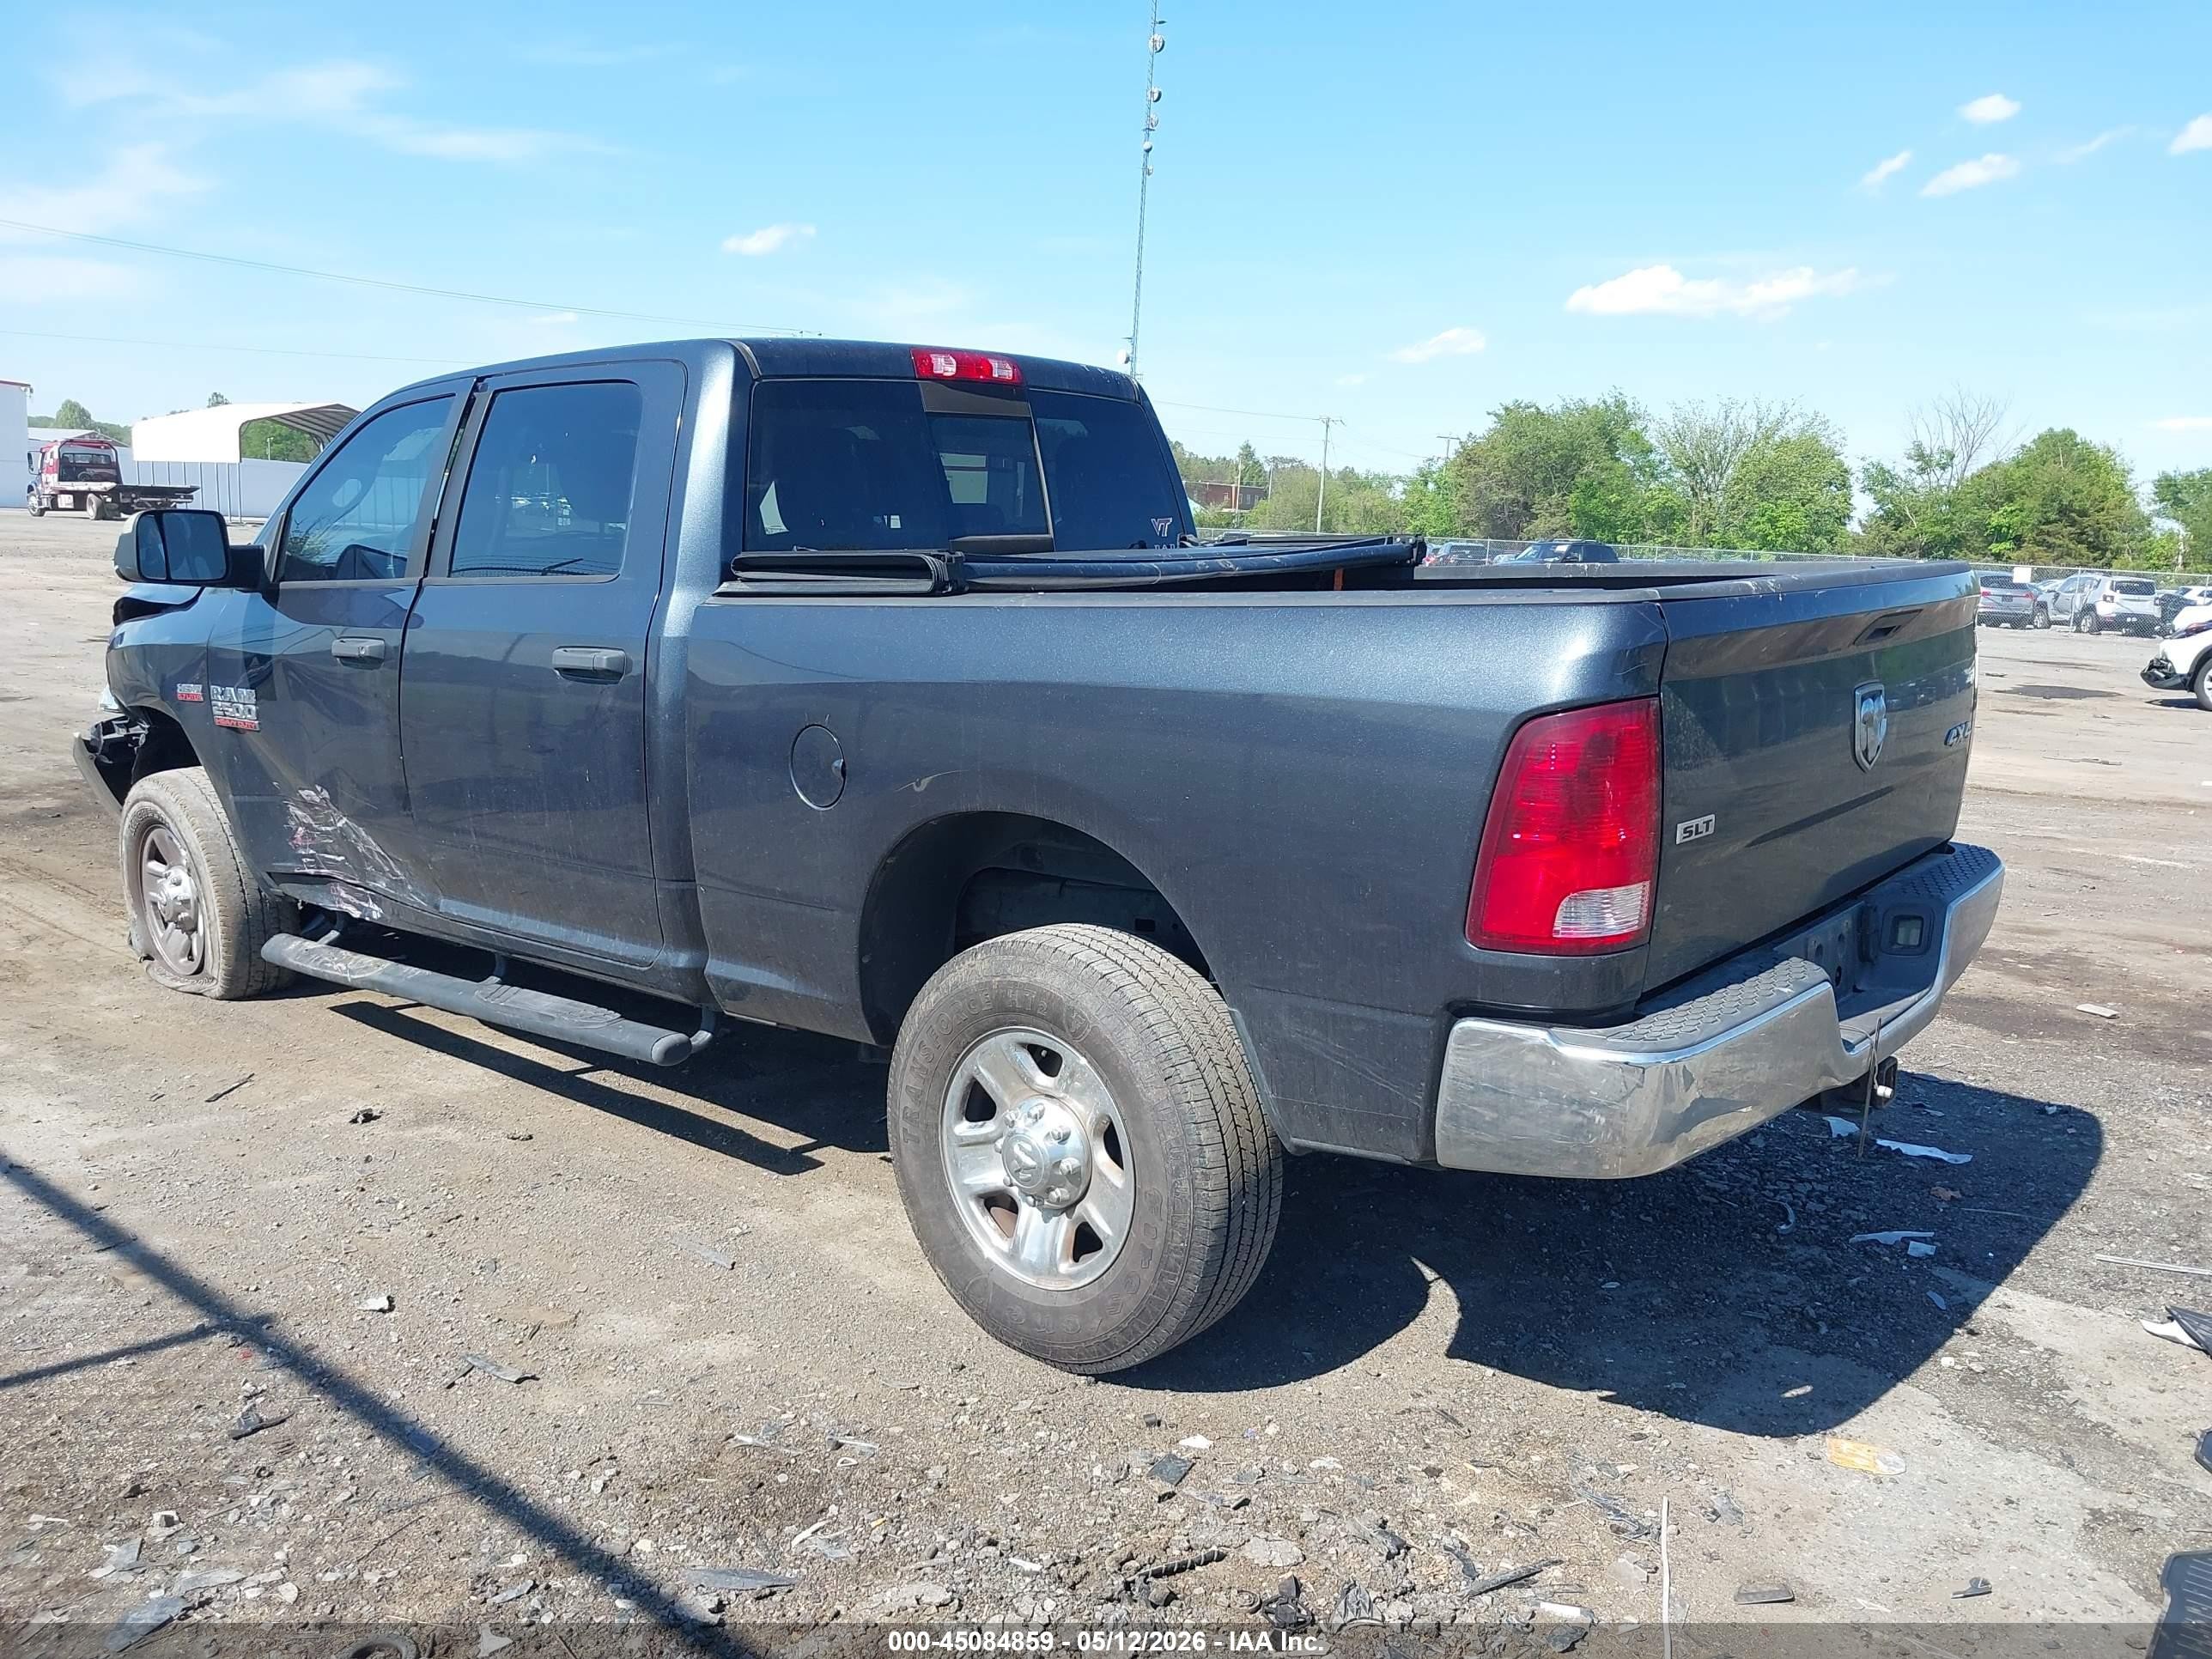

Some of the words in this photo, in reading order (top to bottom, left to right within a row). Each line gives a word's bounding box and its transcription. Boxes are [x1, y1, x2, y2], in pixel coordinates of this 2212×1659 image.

[1151, 517, 1172, 537] VT
[210, 685, 256, 703] RAM
[211, 701, 257, 720] 2500
[1682, 818, 1713, 840] SLT
[902, 989, 994, 1145] TRANSFORCE
